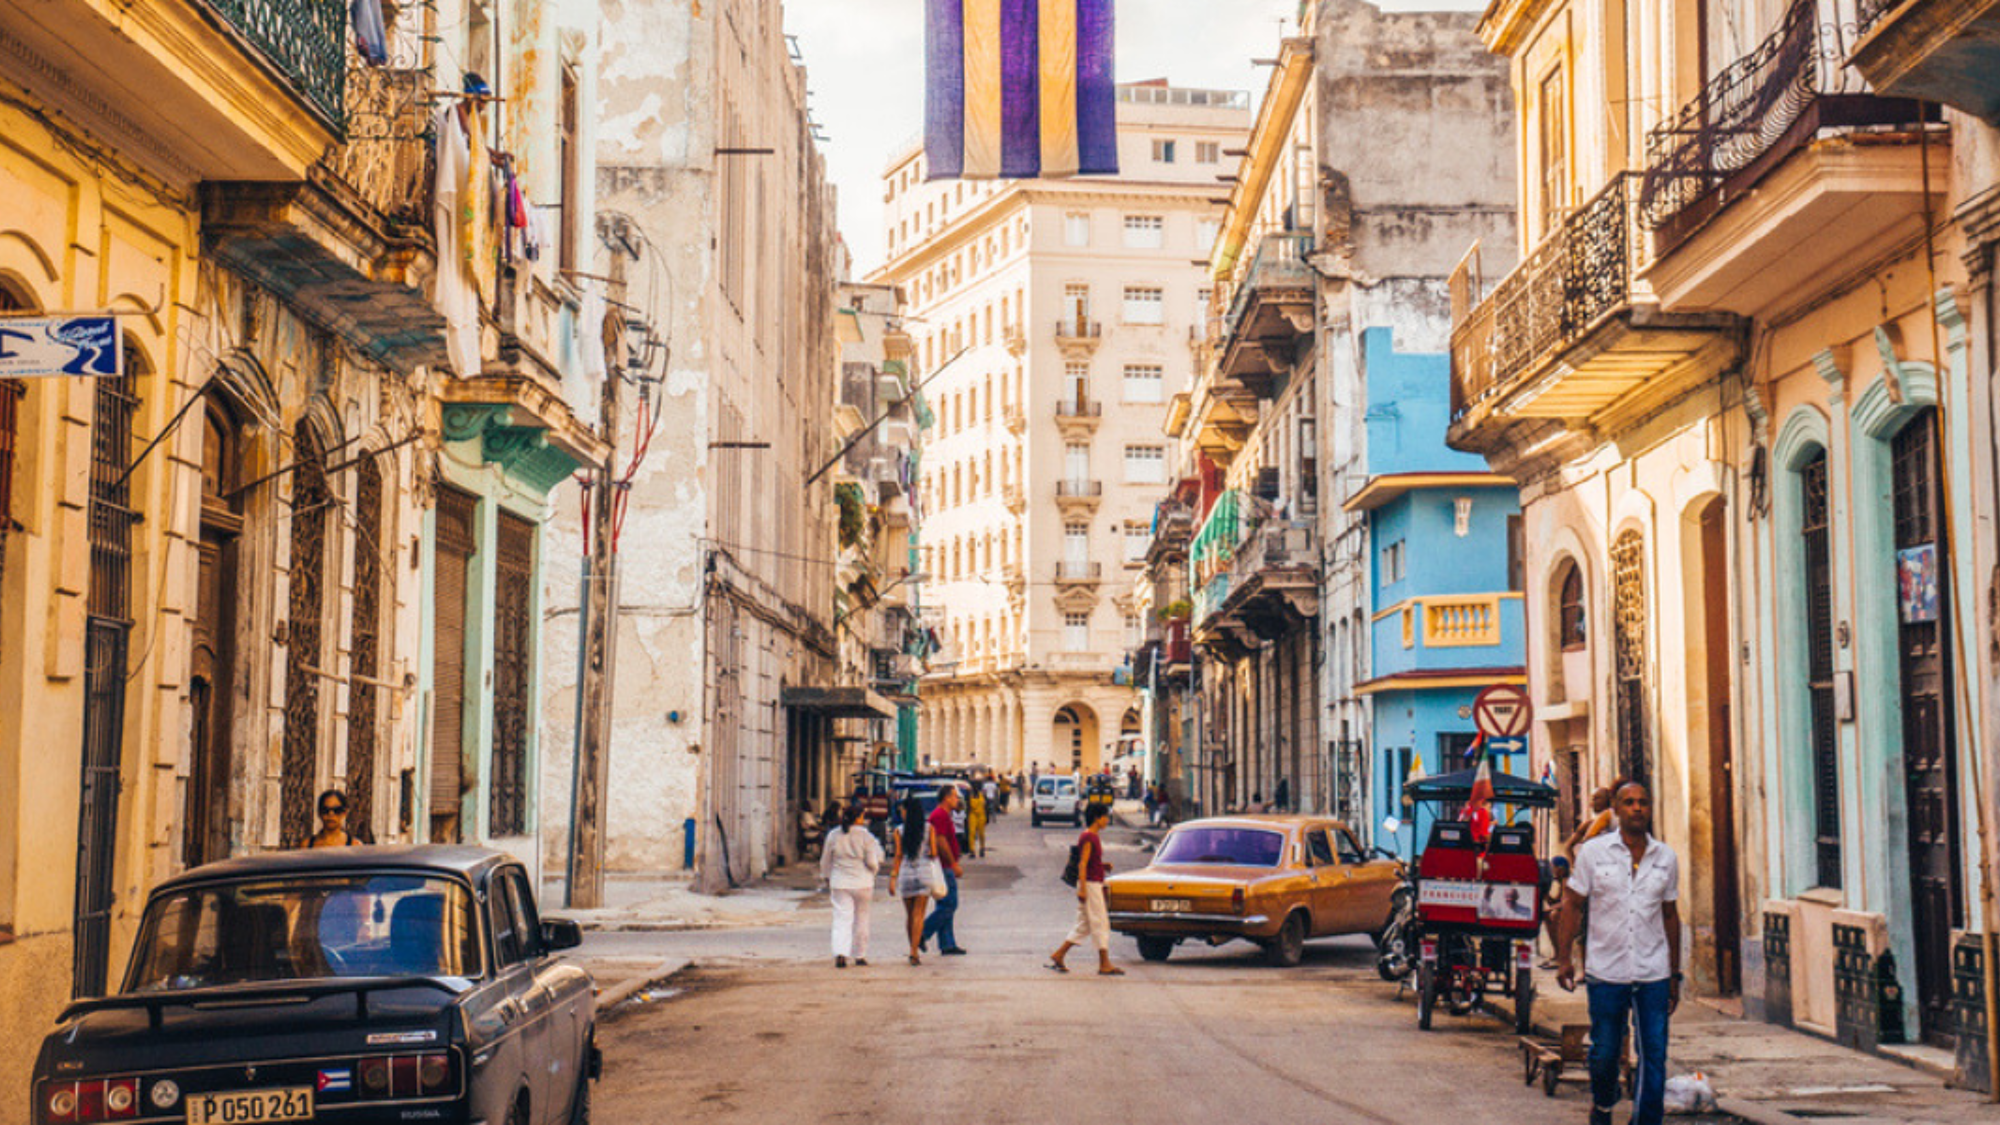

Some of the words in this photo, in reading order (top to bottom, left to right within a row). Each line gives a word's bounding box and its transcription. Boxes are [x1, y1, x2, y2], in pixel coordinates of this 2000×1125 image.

[204, 1099, 217, 1123] P
[223, 1097, 264, 1121] 050
[268, 1091, 310, 1118] 261
